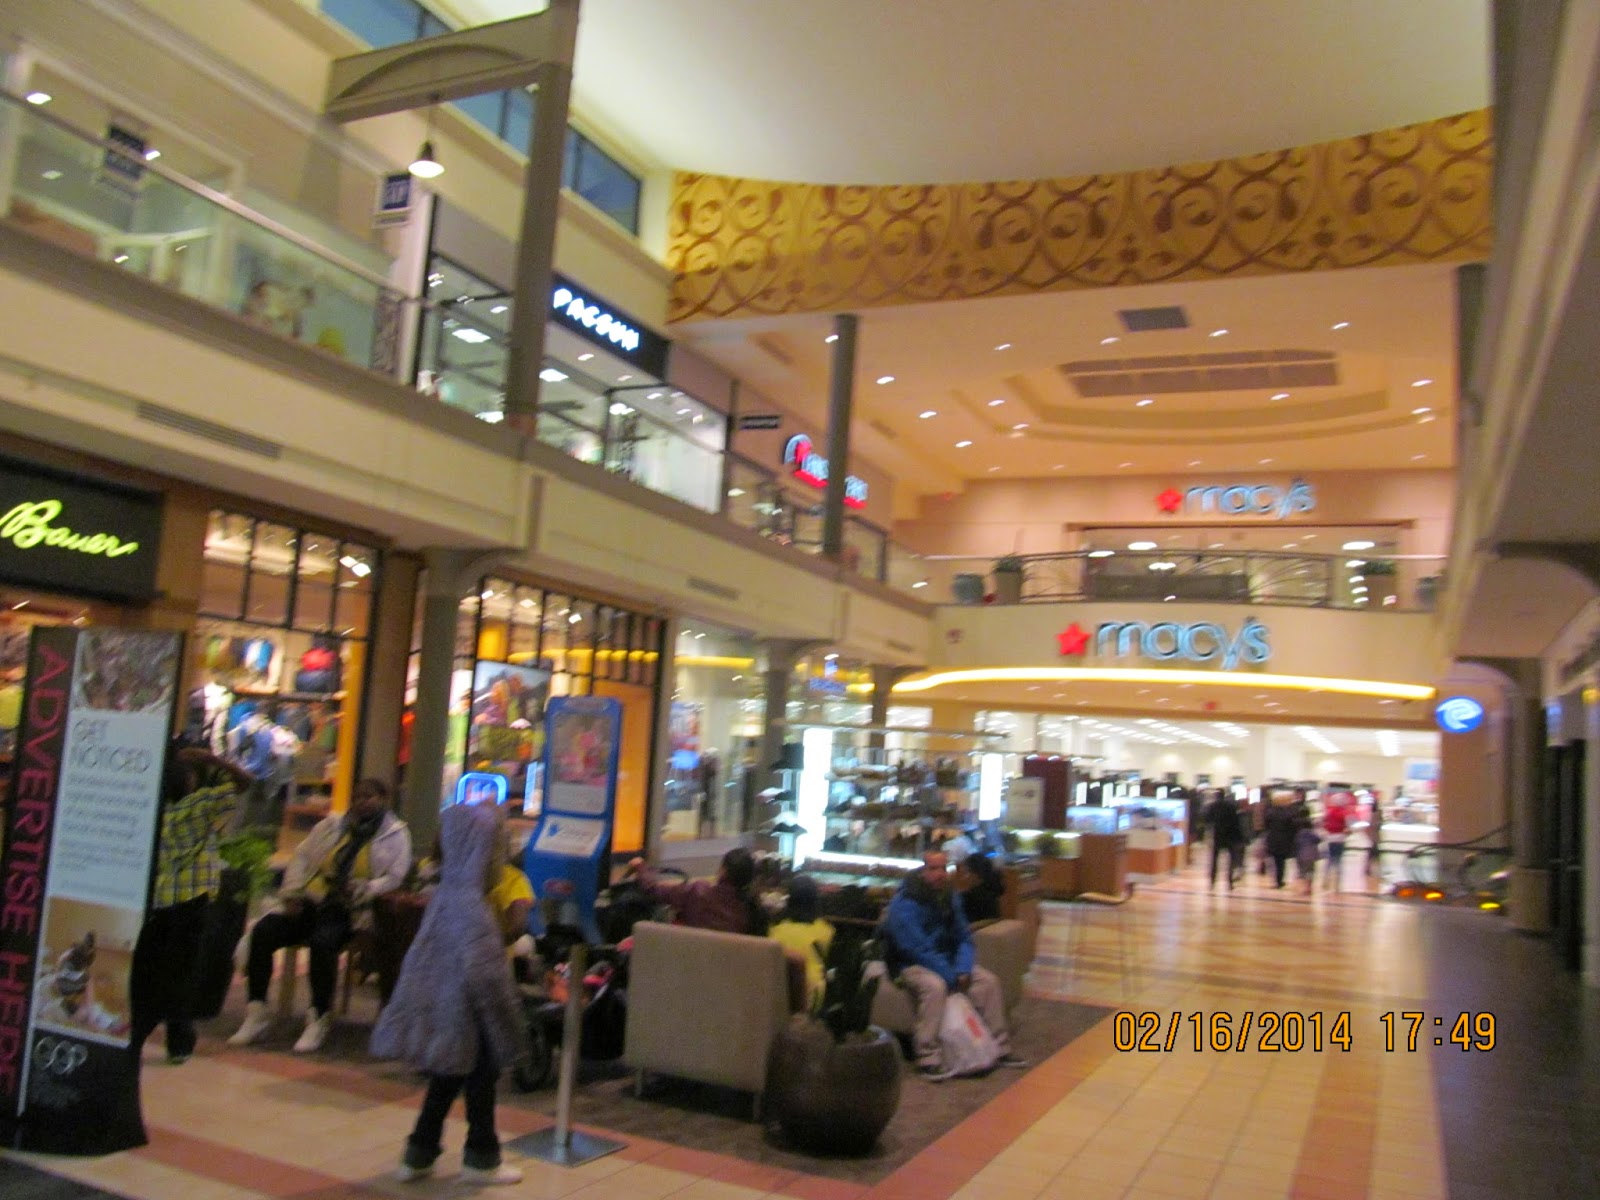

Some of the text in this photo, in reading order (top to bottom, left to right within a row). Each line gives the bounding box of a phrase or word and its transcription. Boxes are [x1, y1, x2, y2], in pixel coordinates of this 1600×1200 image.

[553, 287, 640, 351] PACSUN
[0, 499, 139, 558] Bauer
[1185, 478, 1316, 520] macy's
[1096, 616, 1272, 671] macy's
[1, 648, 69, 936] ADVERTISE
